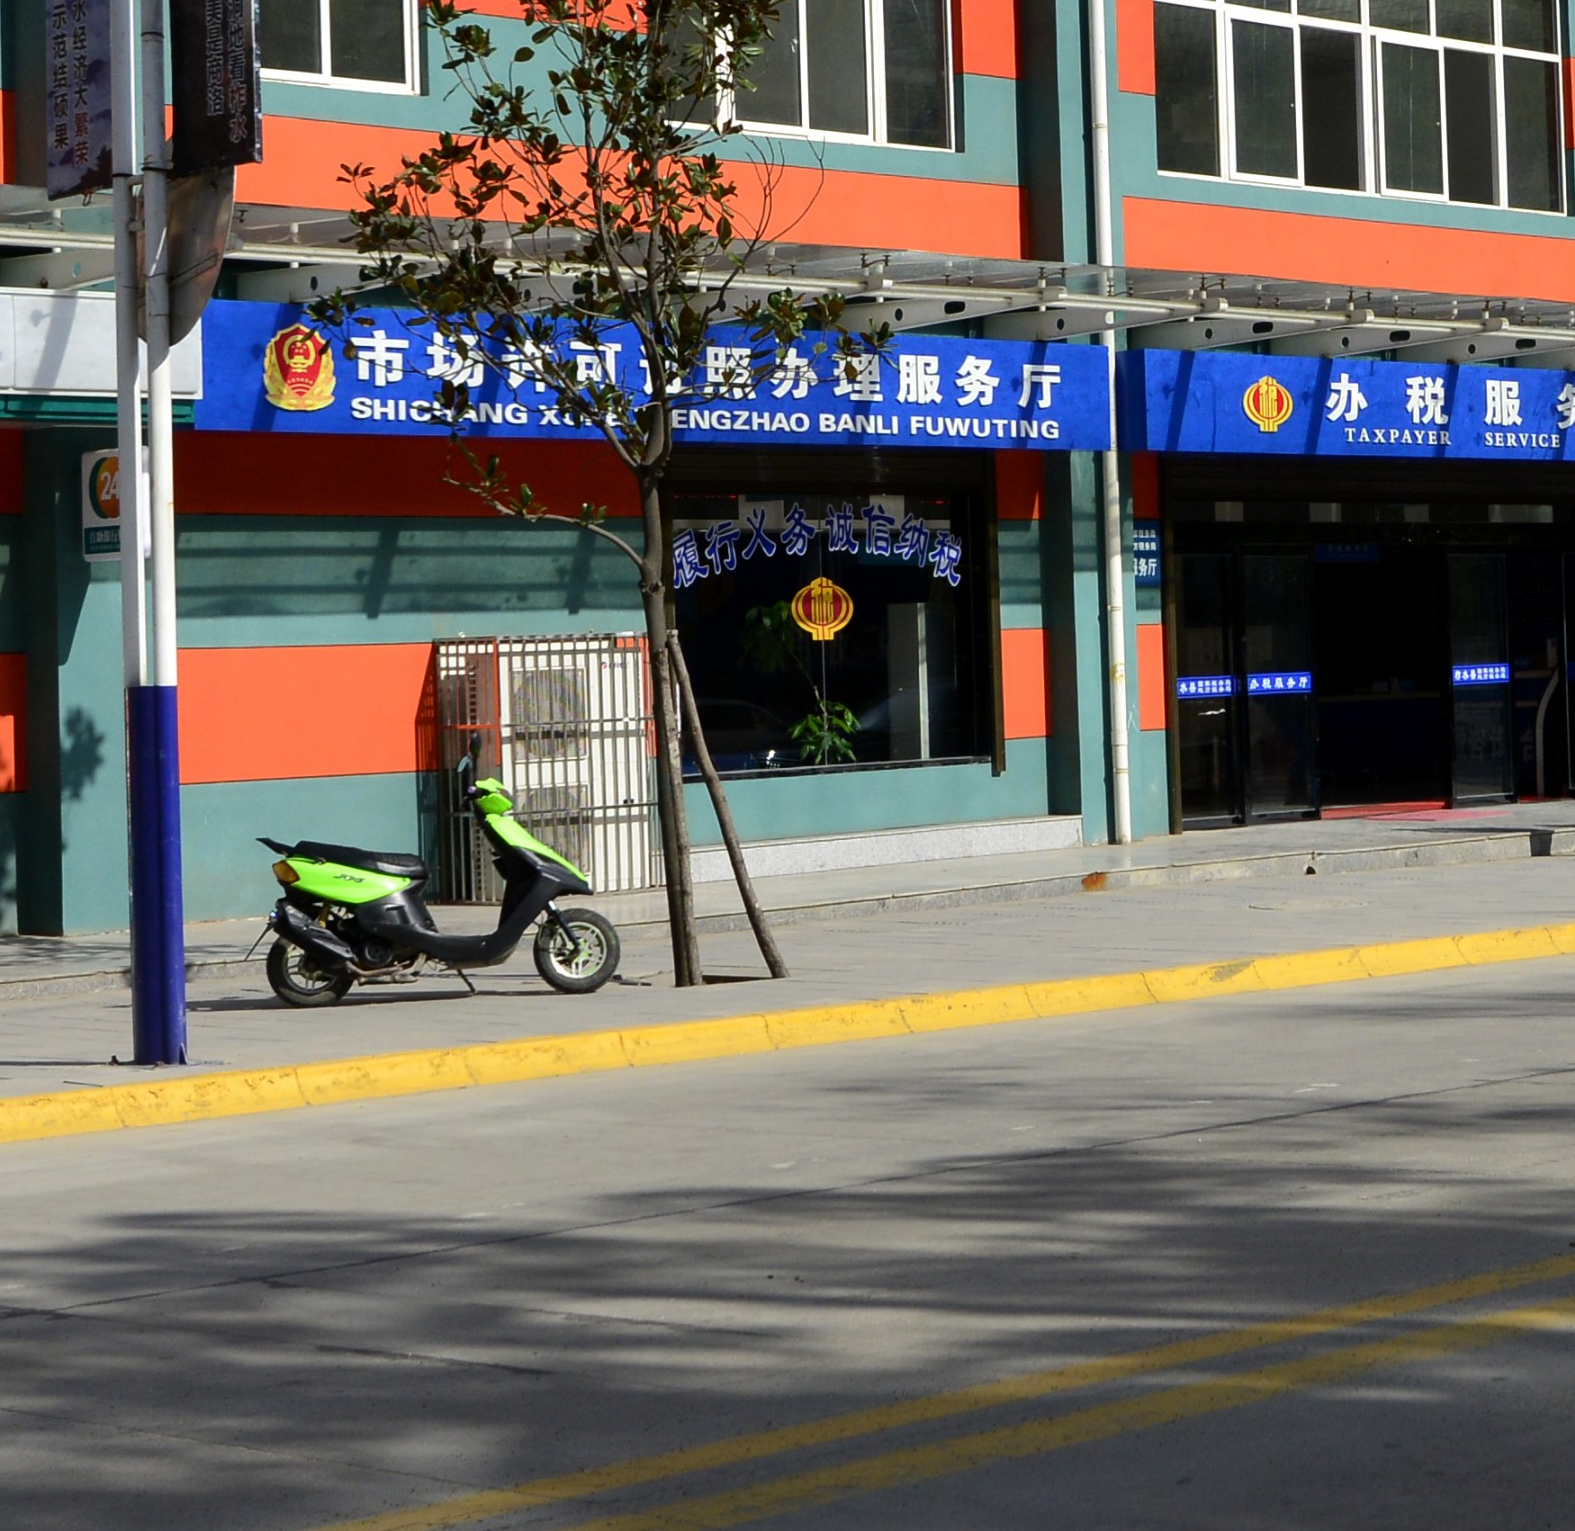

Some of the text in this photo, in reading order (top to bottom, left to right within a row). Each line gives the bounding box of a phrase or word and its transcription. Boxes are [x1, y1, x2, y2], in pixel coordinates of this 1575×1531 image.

[818, 413, 900, 437] BANLI
[909, 416, 1061, 440] FUWUTING
[1343, 426, 1453, 446] TAXPAYER
[1484, 431, 1561, 450] SERVICE
